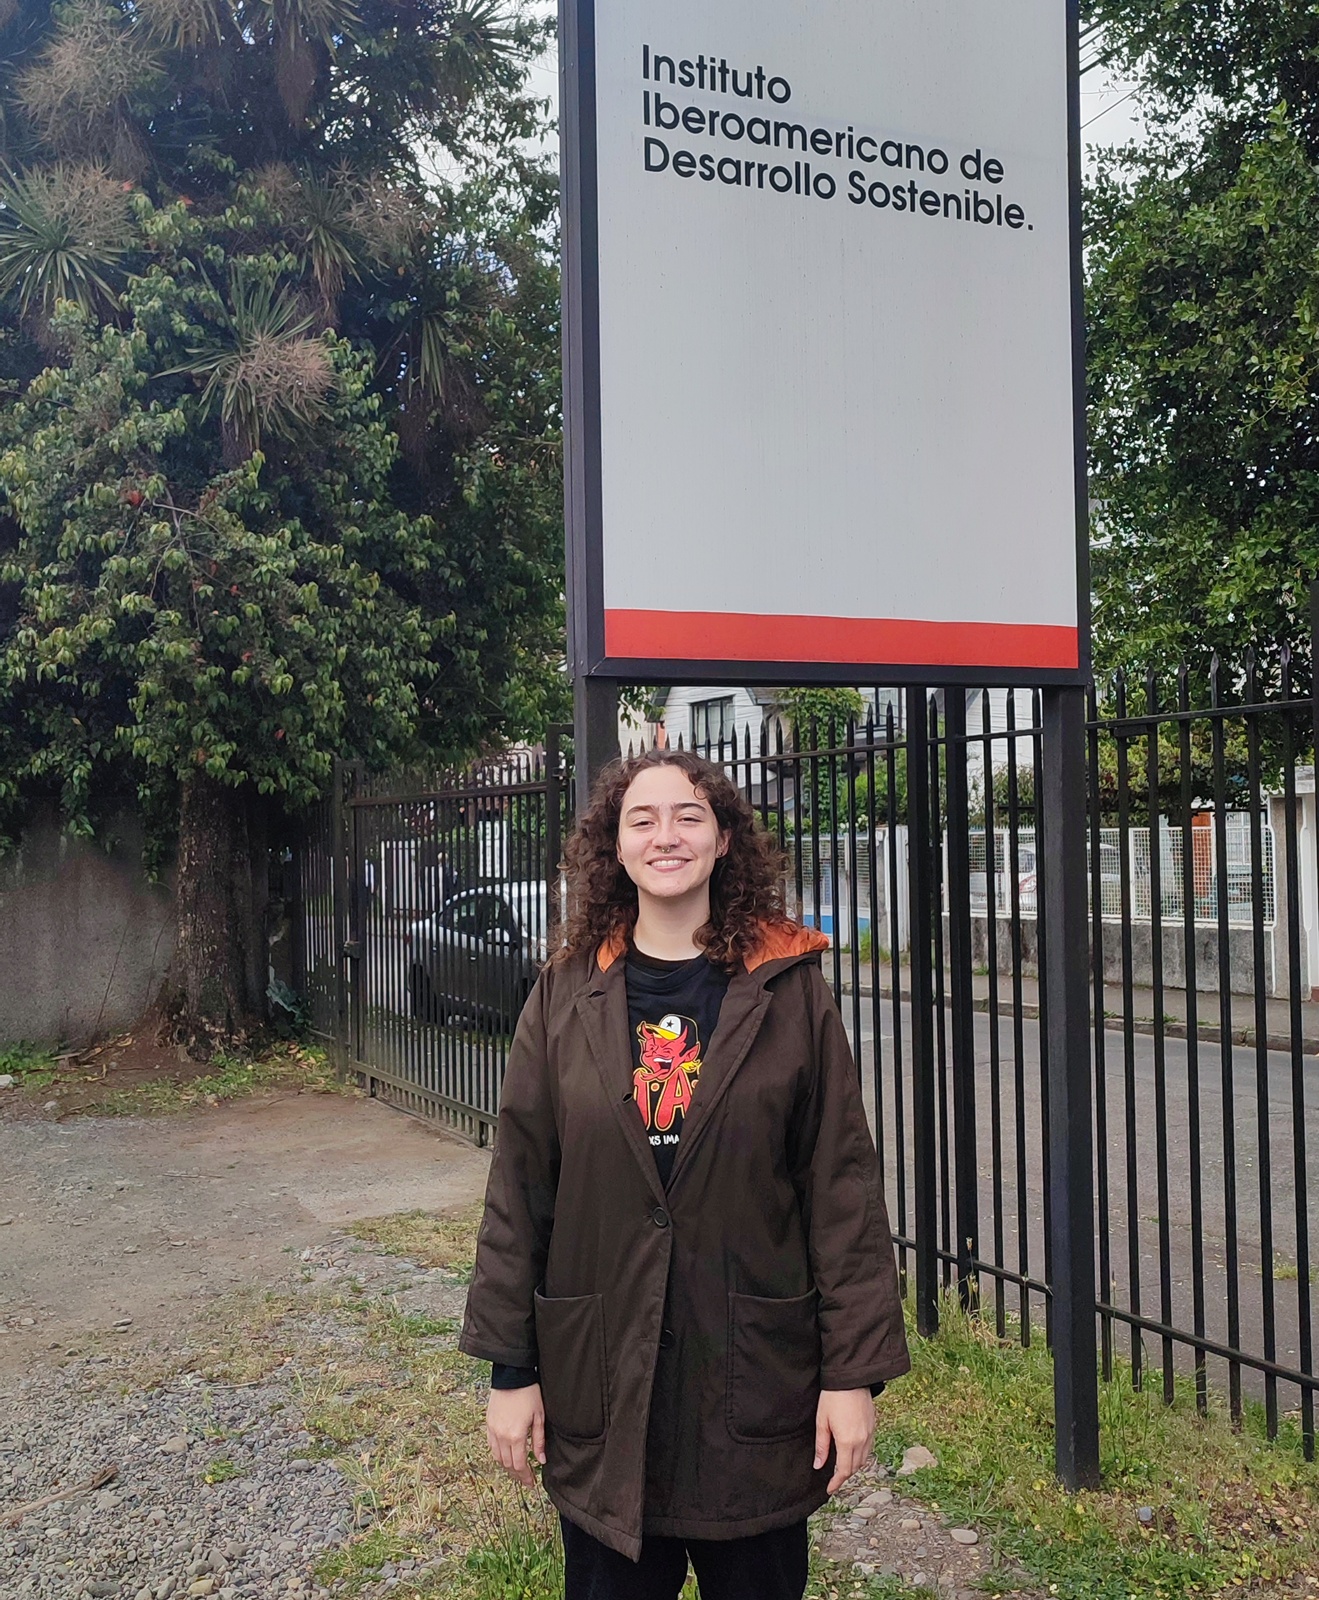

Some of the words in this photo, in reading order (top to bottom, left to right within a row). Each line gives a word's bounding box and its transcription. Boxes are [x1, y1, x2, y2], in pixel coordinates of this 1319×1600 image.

[642, 44, 792, 104] Instituto
[643, 90, 949, 175] Iberoamericano
[959, 148, 1004, 184] de
[644, 136, 837, 200] Desarrollo
[847, 170, 1034, 231] Sostenible.
